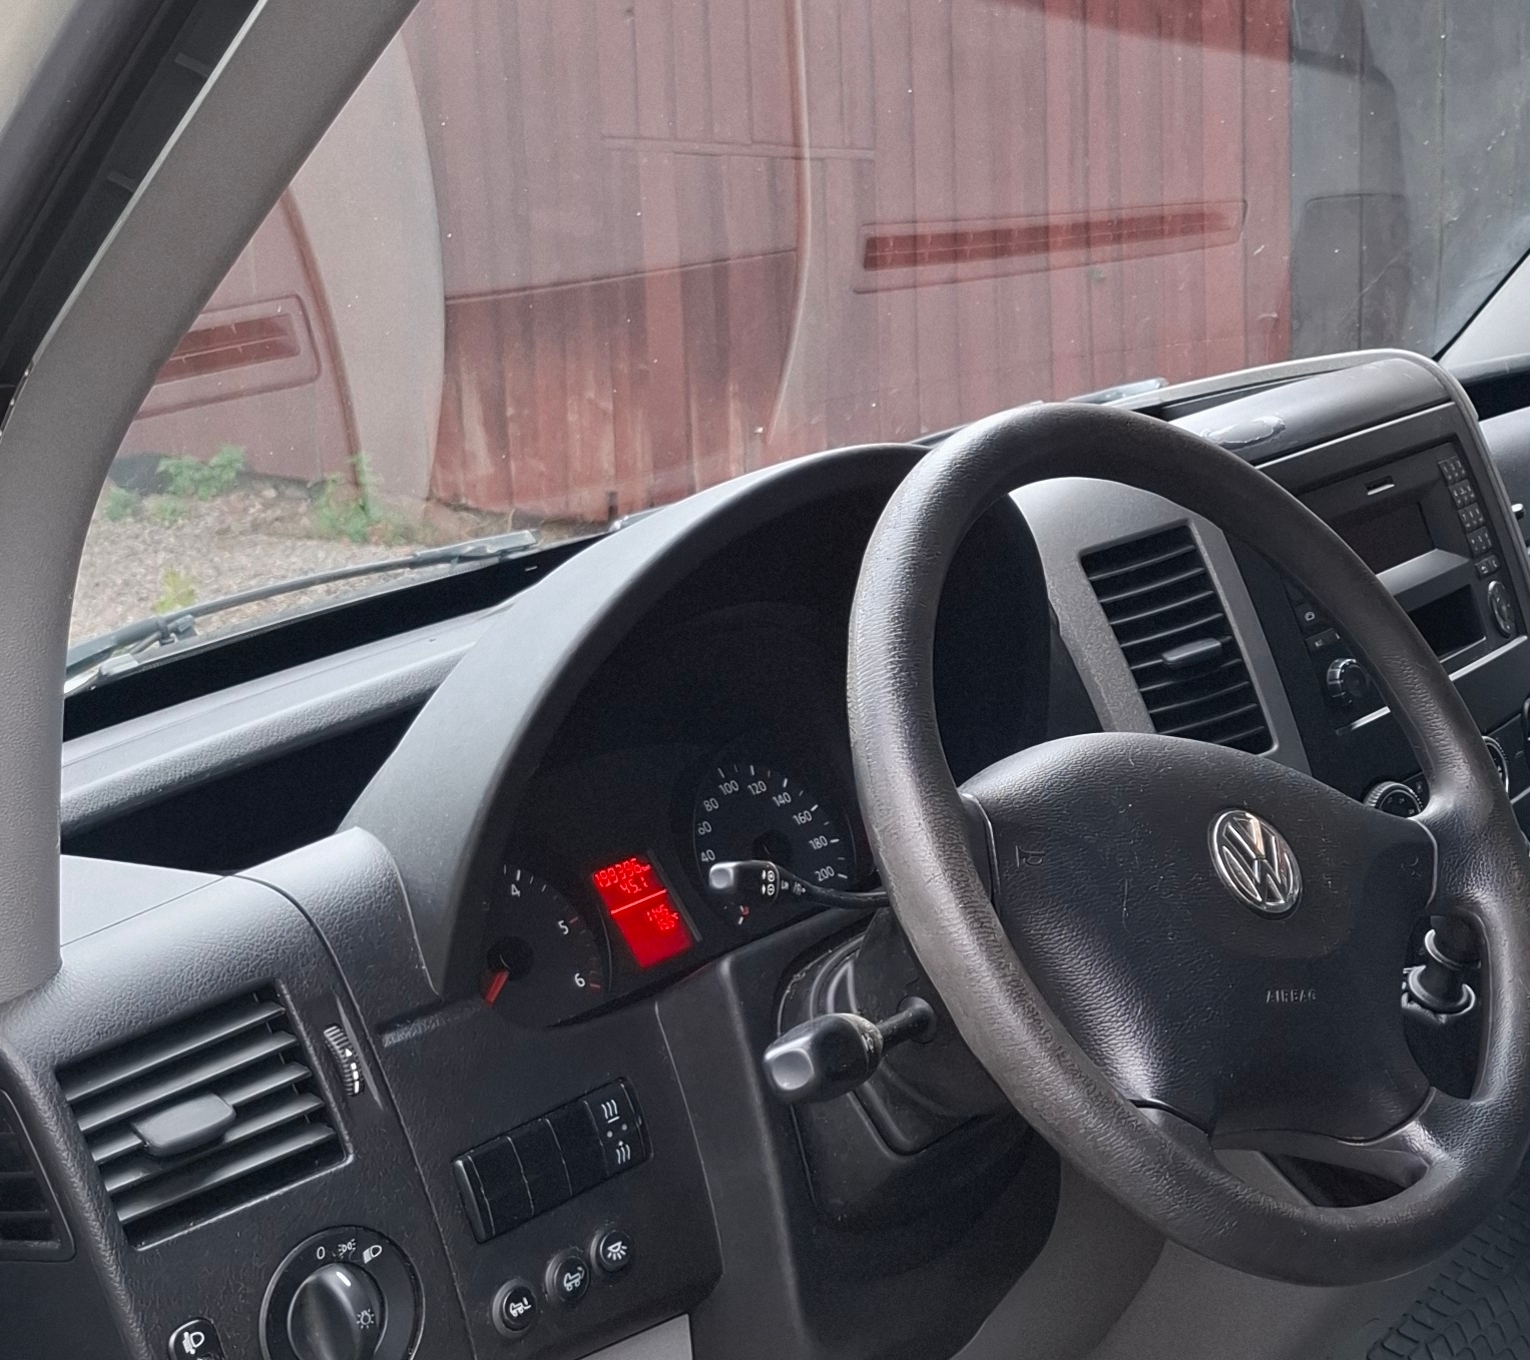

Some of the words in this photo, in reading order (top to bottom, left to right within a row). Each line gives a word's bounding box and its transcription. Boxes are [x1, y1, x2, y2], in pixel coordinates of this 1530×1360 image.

[719, 780, 739, 795] 100
[747, 780, 767, 795] 120
[703, 797, 720, 812] 80
[772, 792, 792, 807] 140
[792, 810, 813, 825] 160
[698, 820, 712, 835] 60
[808, 835, 829, 850] 180
[700, 849, 716, 863] 40
[814, 866, 835, 882] 200
[511, 884, 521, 897] 4
[558, 920, 569, 935] 5
[574, 973, 586, 988] 6
[1266, 990, 1316, 1003] AIRBAG
